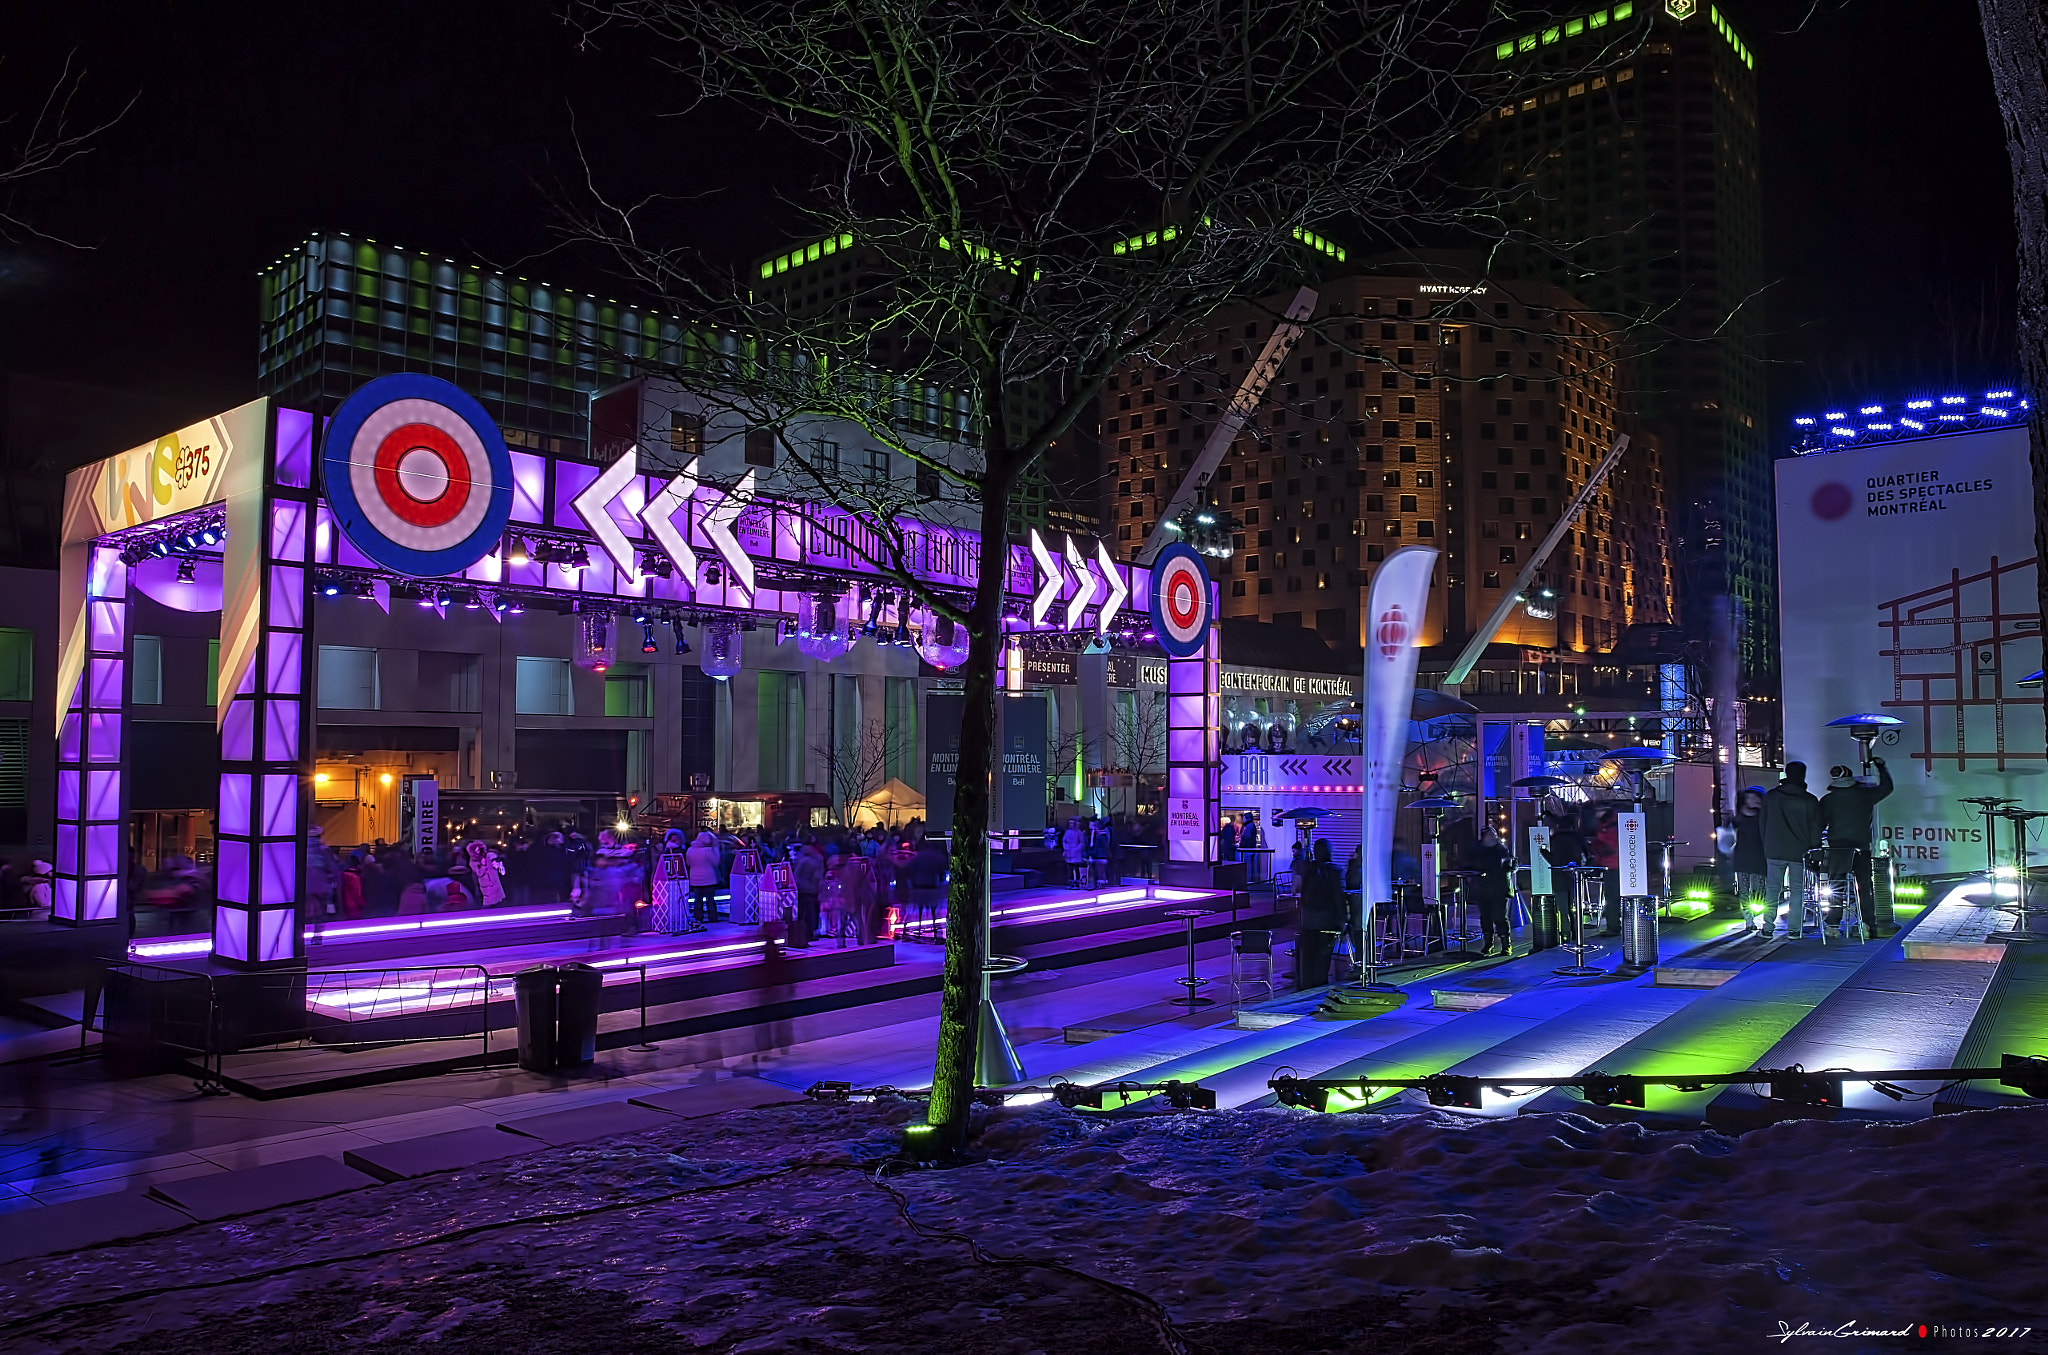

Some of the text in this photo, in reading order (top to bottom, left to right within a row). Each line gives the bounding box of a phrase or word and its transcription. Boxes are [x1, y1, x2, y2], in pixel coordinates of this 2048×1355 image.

[1419, 285, 1448, 293] HYATT
[1867, 470, 1939, 488] QUARTIER
[1867, 479, 1993, 502] DES SPECTACLES
[1867, 498, 1947, 517] MONTRÉAL
[1027, 660, 1070, 674] PRÉSENTER
[1141, 665, 1353, 697] MUS CONTEMPORAIN DE MONTRÉAL
[930, 763, 941, 772] EN
[1008, 763, 1042, 774] LUMIÈRE
[1240, 755, 1269, 786] BAR
[1012, 777, 1025, 786] Bell
[1881, 826, 1982, 843] DE POINTS
